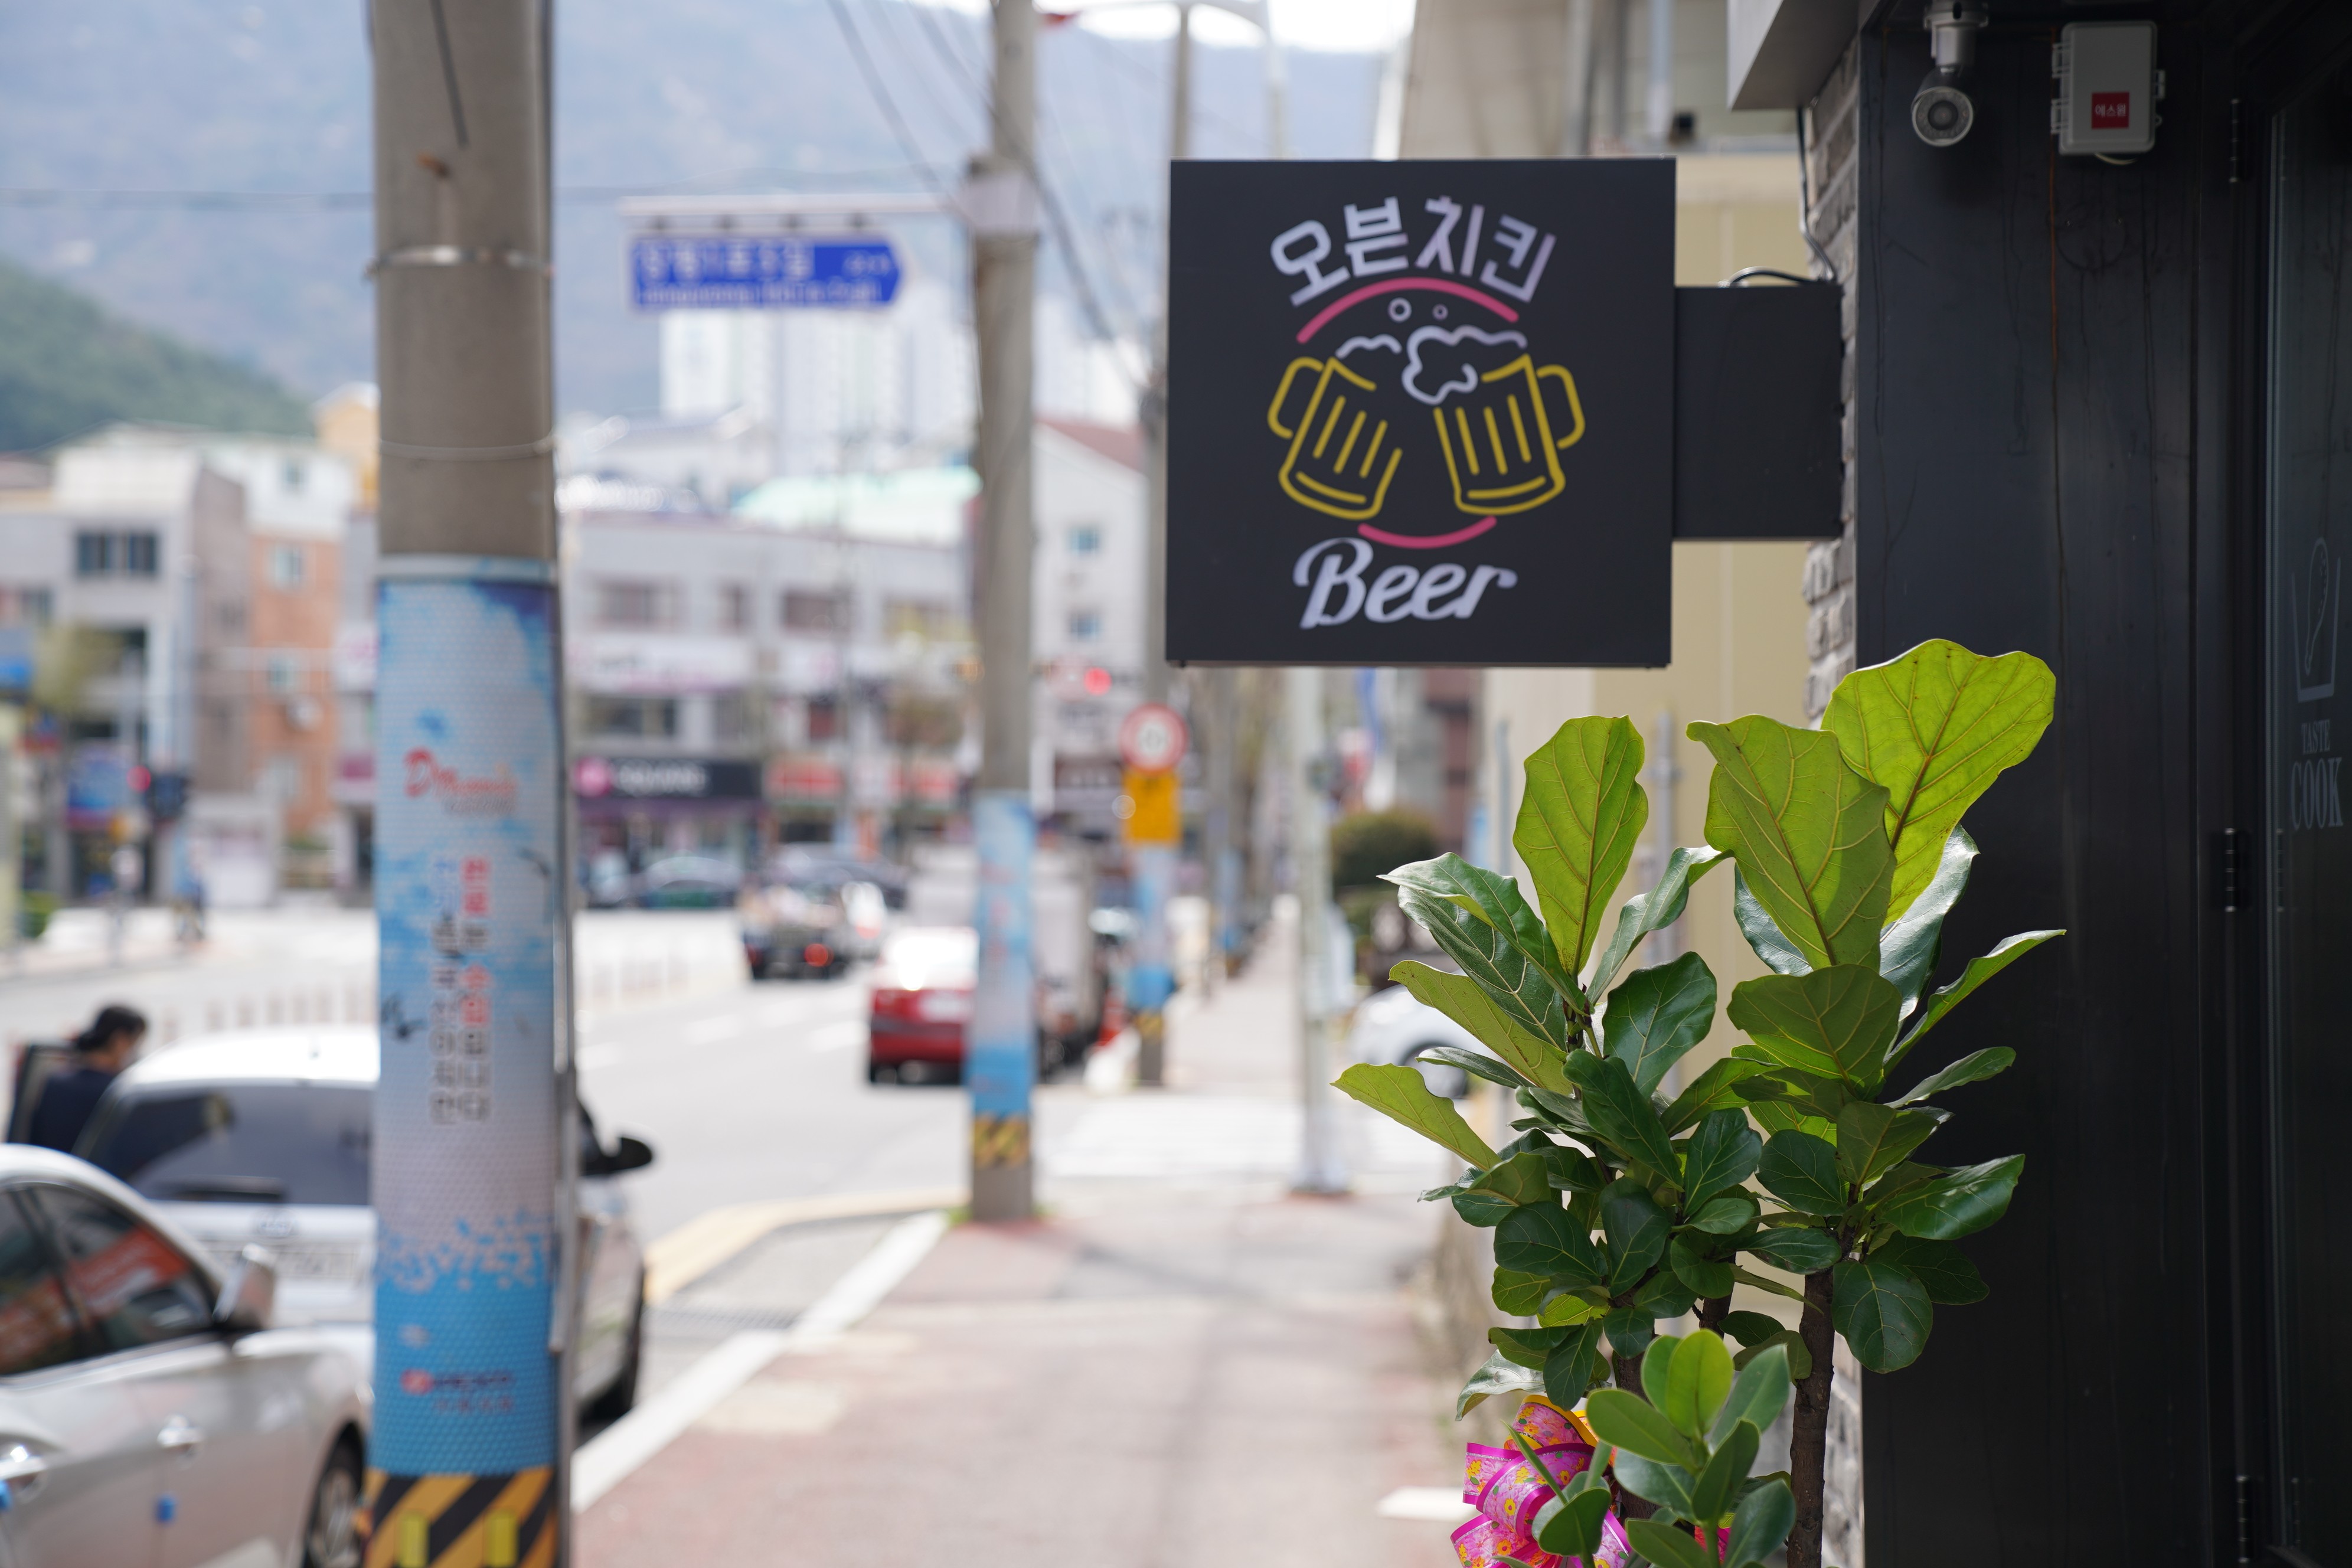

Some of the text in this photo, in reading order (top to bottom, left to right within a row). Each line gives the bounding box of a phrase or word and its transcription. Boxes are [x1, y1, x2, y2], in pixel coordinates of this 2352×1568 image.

[2094, 103, 2127, 117] 에스원
[1270, 195, 1557, 307] 오븐치킨
[1293, 537, 1518, 631] Beer
[2301, 718, 2331, 755] TASTE
[2291, 757, 2344, 831] COOK
